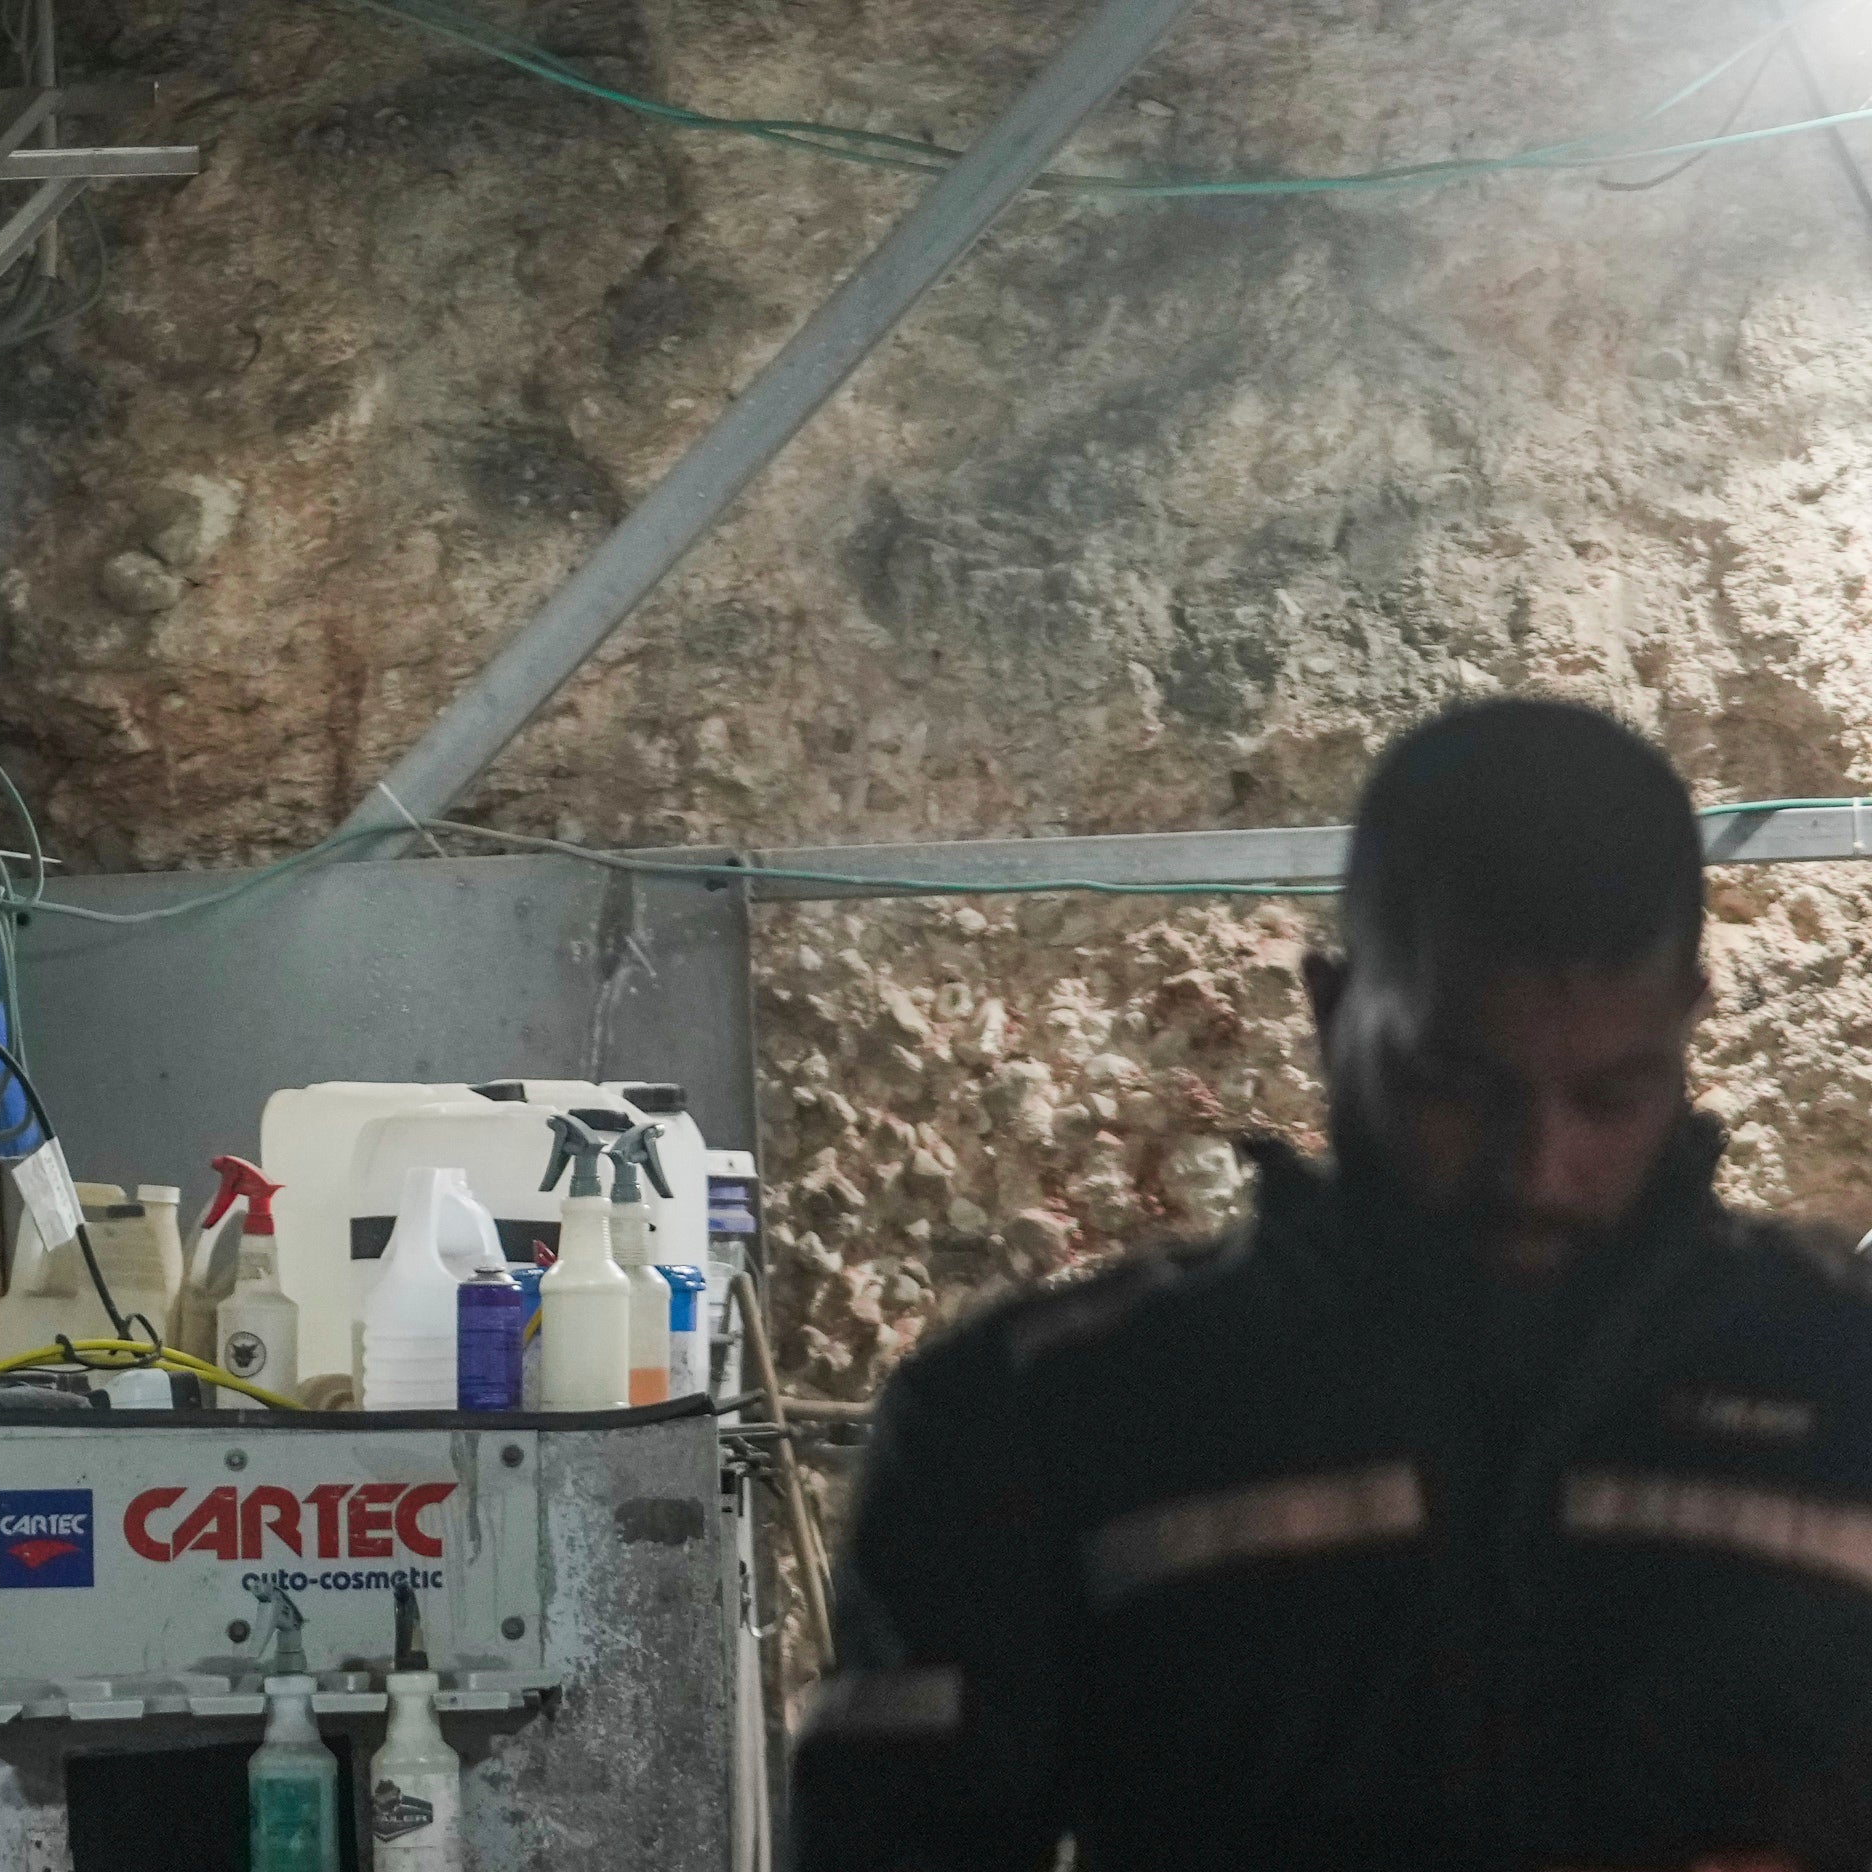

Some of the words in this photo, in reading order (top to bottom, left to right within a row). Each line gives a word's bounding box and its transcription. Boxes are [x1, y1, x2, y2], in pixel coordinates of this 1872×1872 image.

[0, 1513, 87, 1535] CARTEC
[123, 1482, 459, 1563] CARTEC
[241, 1566, 443, 1591] auto-cosmetic
